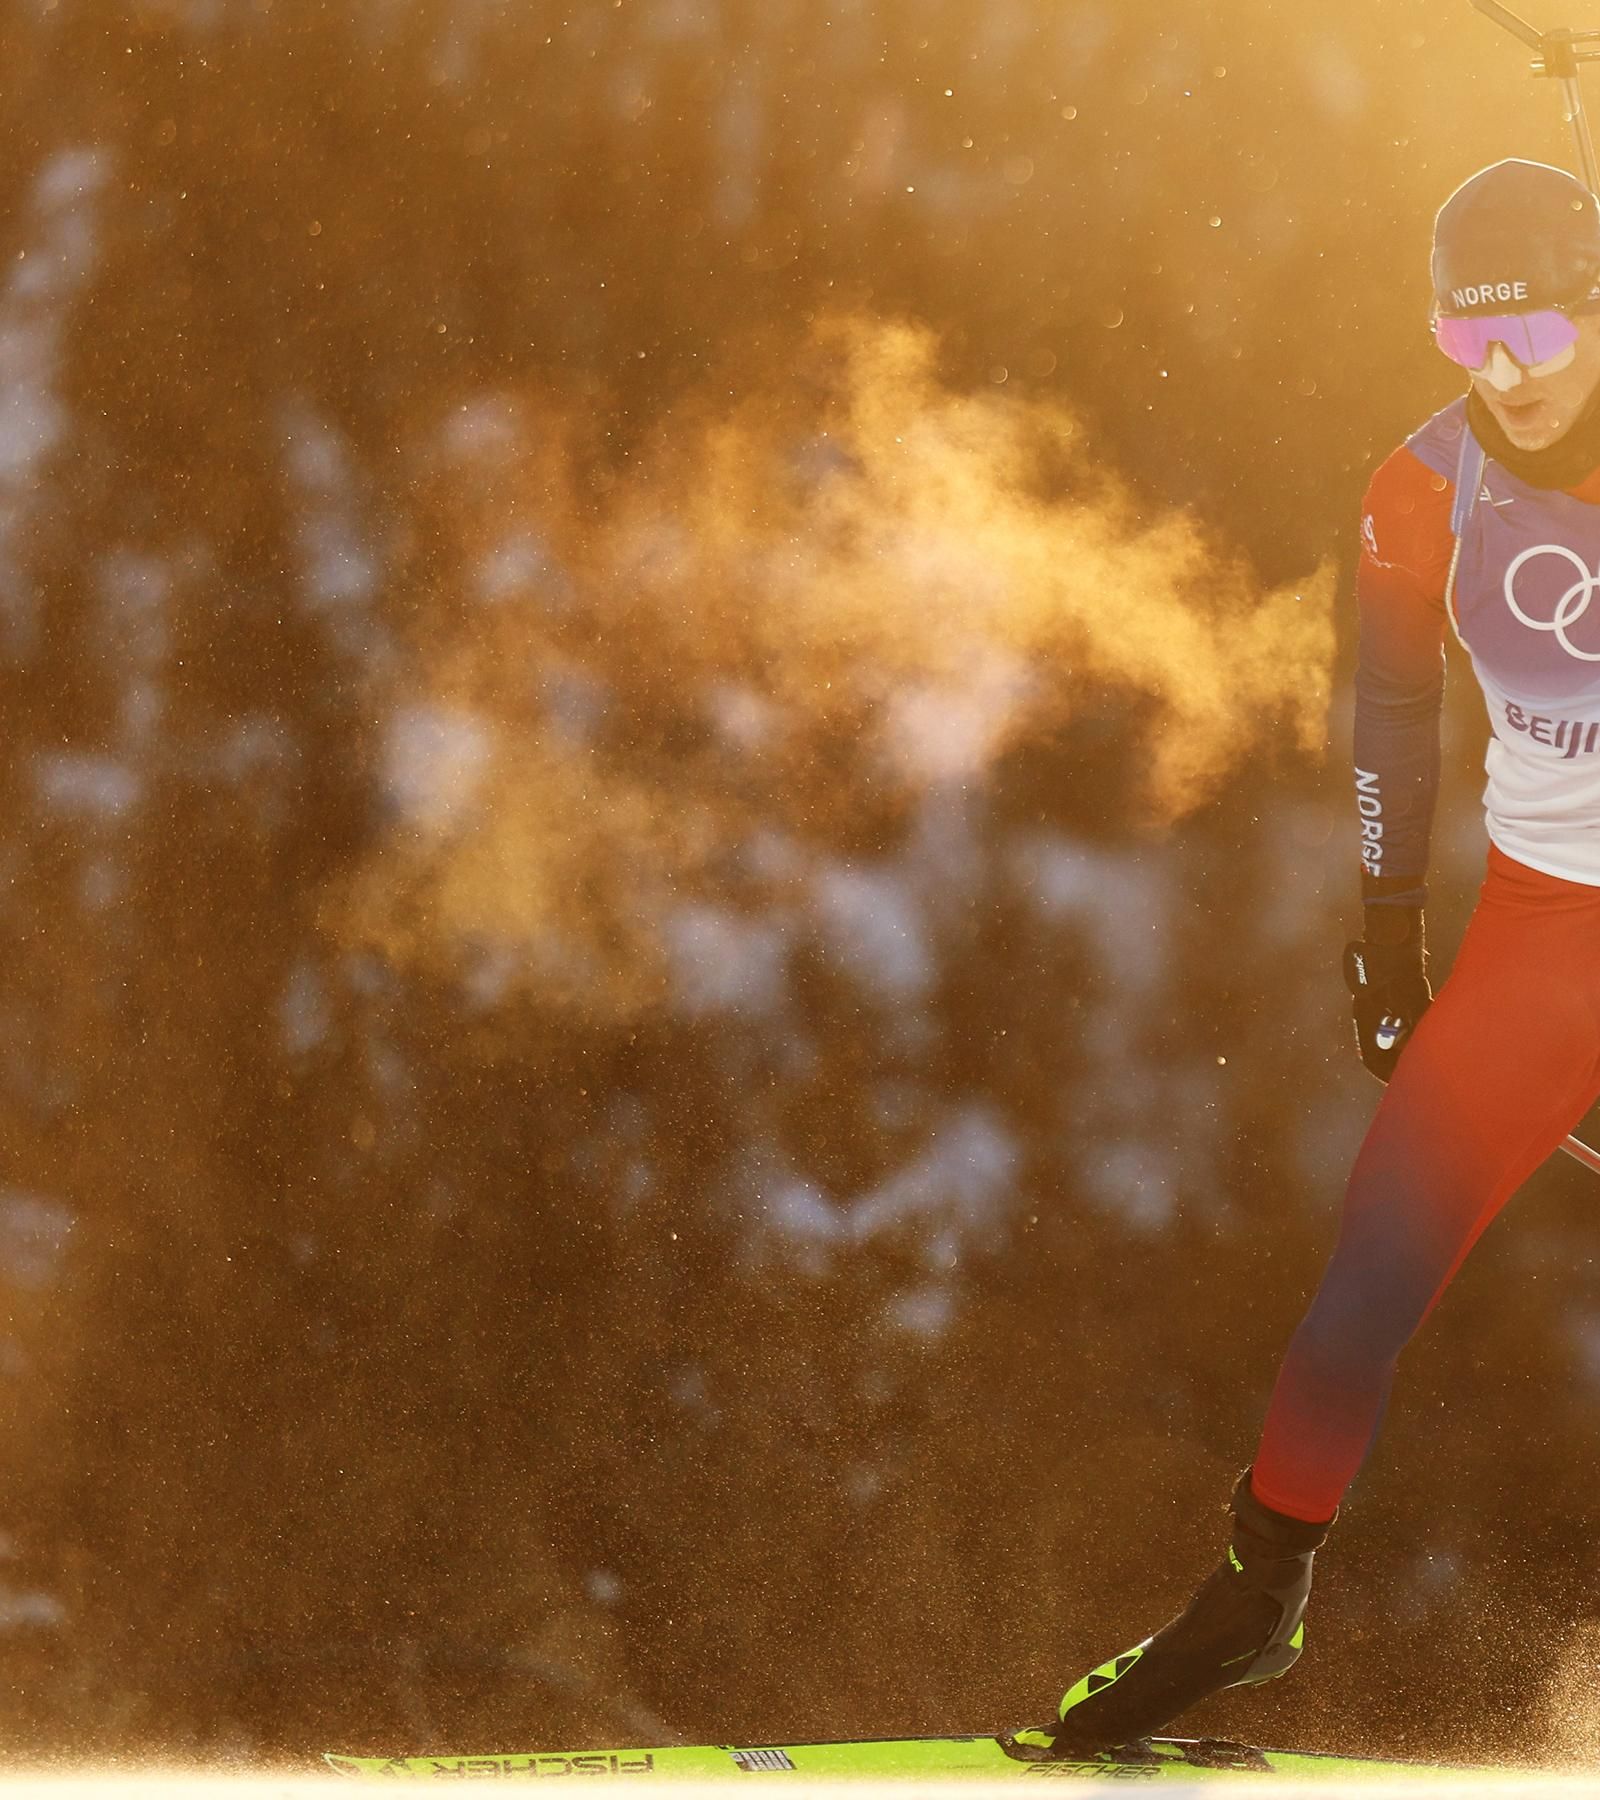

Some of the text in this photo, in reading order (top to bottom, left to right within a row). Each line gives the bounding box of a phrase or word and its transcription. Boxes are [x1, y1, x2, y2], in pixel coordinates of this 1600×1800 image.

[1451, 281, 1528, 308] NORGE
[431, 1753, 655, 1779] FISCHER
[1020, 1763, 1162, 1780] FISCHER
